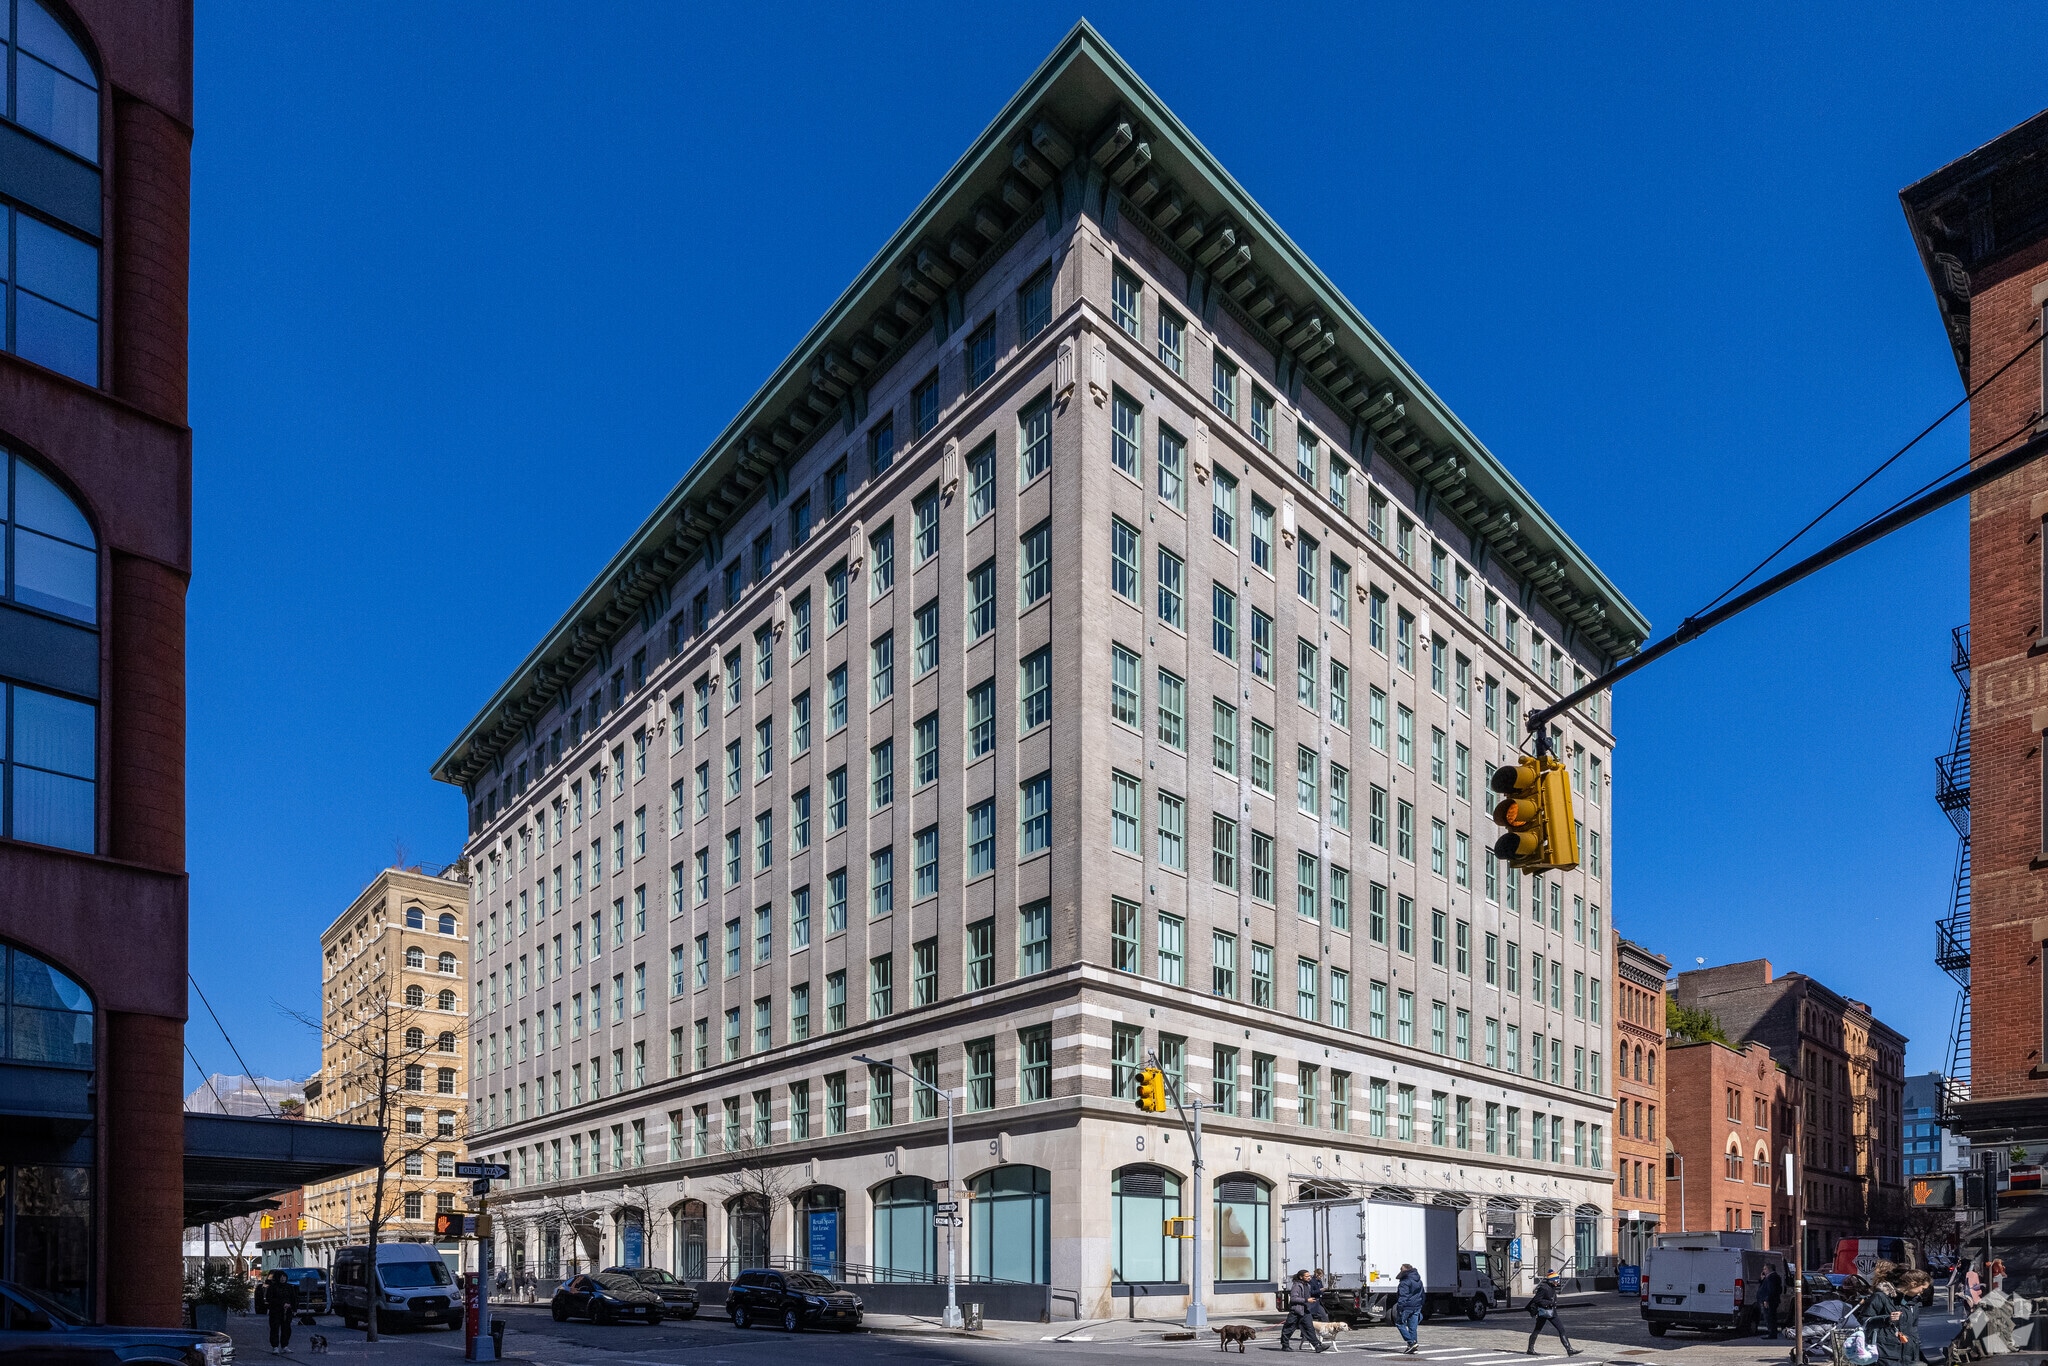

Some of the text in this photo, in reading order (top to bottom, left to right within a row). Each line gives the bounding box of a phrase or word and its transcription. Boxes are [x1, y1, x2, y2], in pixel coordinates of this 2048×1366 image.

[989, 1140, 998, 1156] 9
[1135, 1135, 1145, 1152] 8
[1234, 1146, 1242, 1162] 7
[884, 1153, 895, 1169] 10
[1315, 1155, 1323, 1170] 6
[485, 1167, 502, 1175] WAY
[804, 1164, 811, 1177] 11
[1385, 1164, 1392, 1178] 5
[1445, 1171, 1451, 1183] 4
[676, 1181, 684, 1193] 13
[1496, 1176, 1503, 1189] 3
[823, 1218, 835, 1226] Space
[1512, 1238, 1520, 1259] PARK
[1621, 1276, 1638, 1285] $12.67
